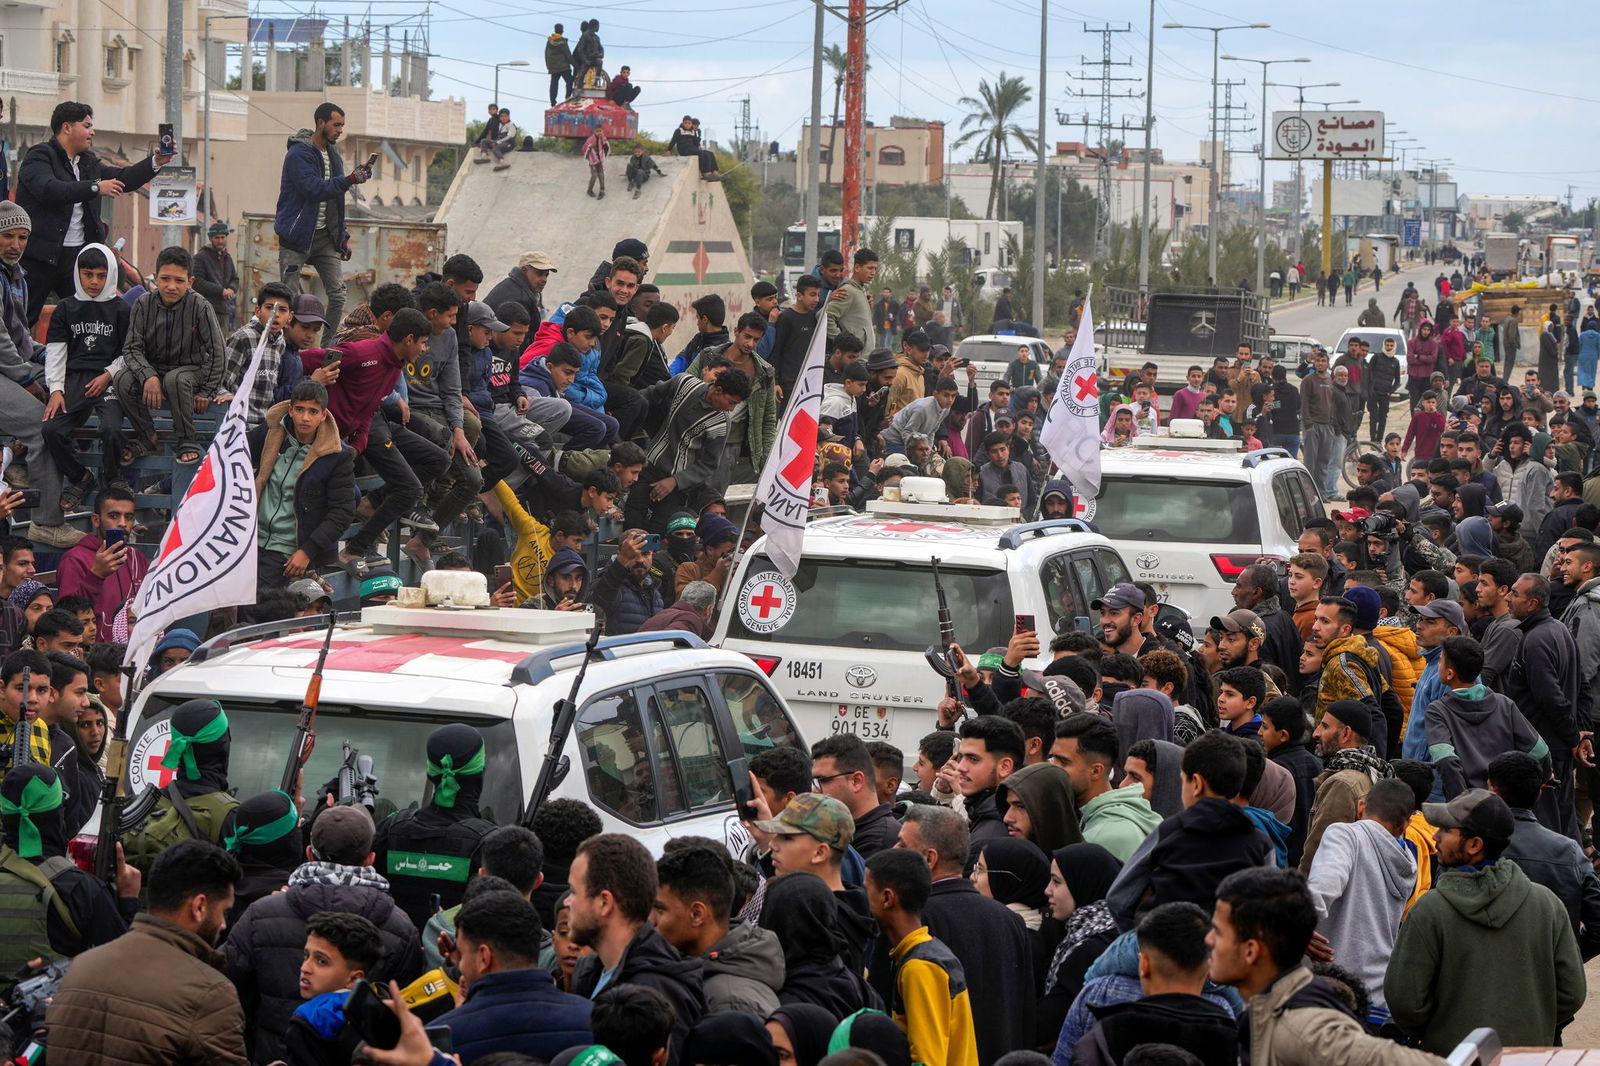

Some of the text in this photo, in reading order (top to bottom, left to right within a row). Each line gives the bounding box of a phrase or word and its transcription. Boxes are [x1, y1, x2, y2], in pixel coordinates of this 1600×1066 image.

[1317, 116, 1375, 135] مصانع
[1317, 138, 1375, 155] العودة
[1139, 572, 1195, 581] CRUISER
[739, 571, 796, 620] COMITE INTERNATIONAL
[745, 618, 780, 632] GENEVE
[786, 660, 822, 680] 18451
[797, 689, 924, 703] LAND CRUISER
[1044, 680, 1073, 718] adida
[854, 705, 870, 719] GE
[131, 733, 152, 785] COMITE
